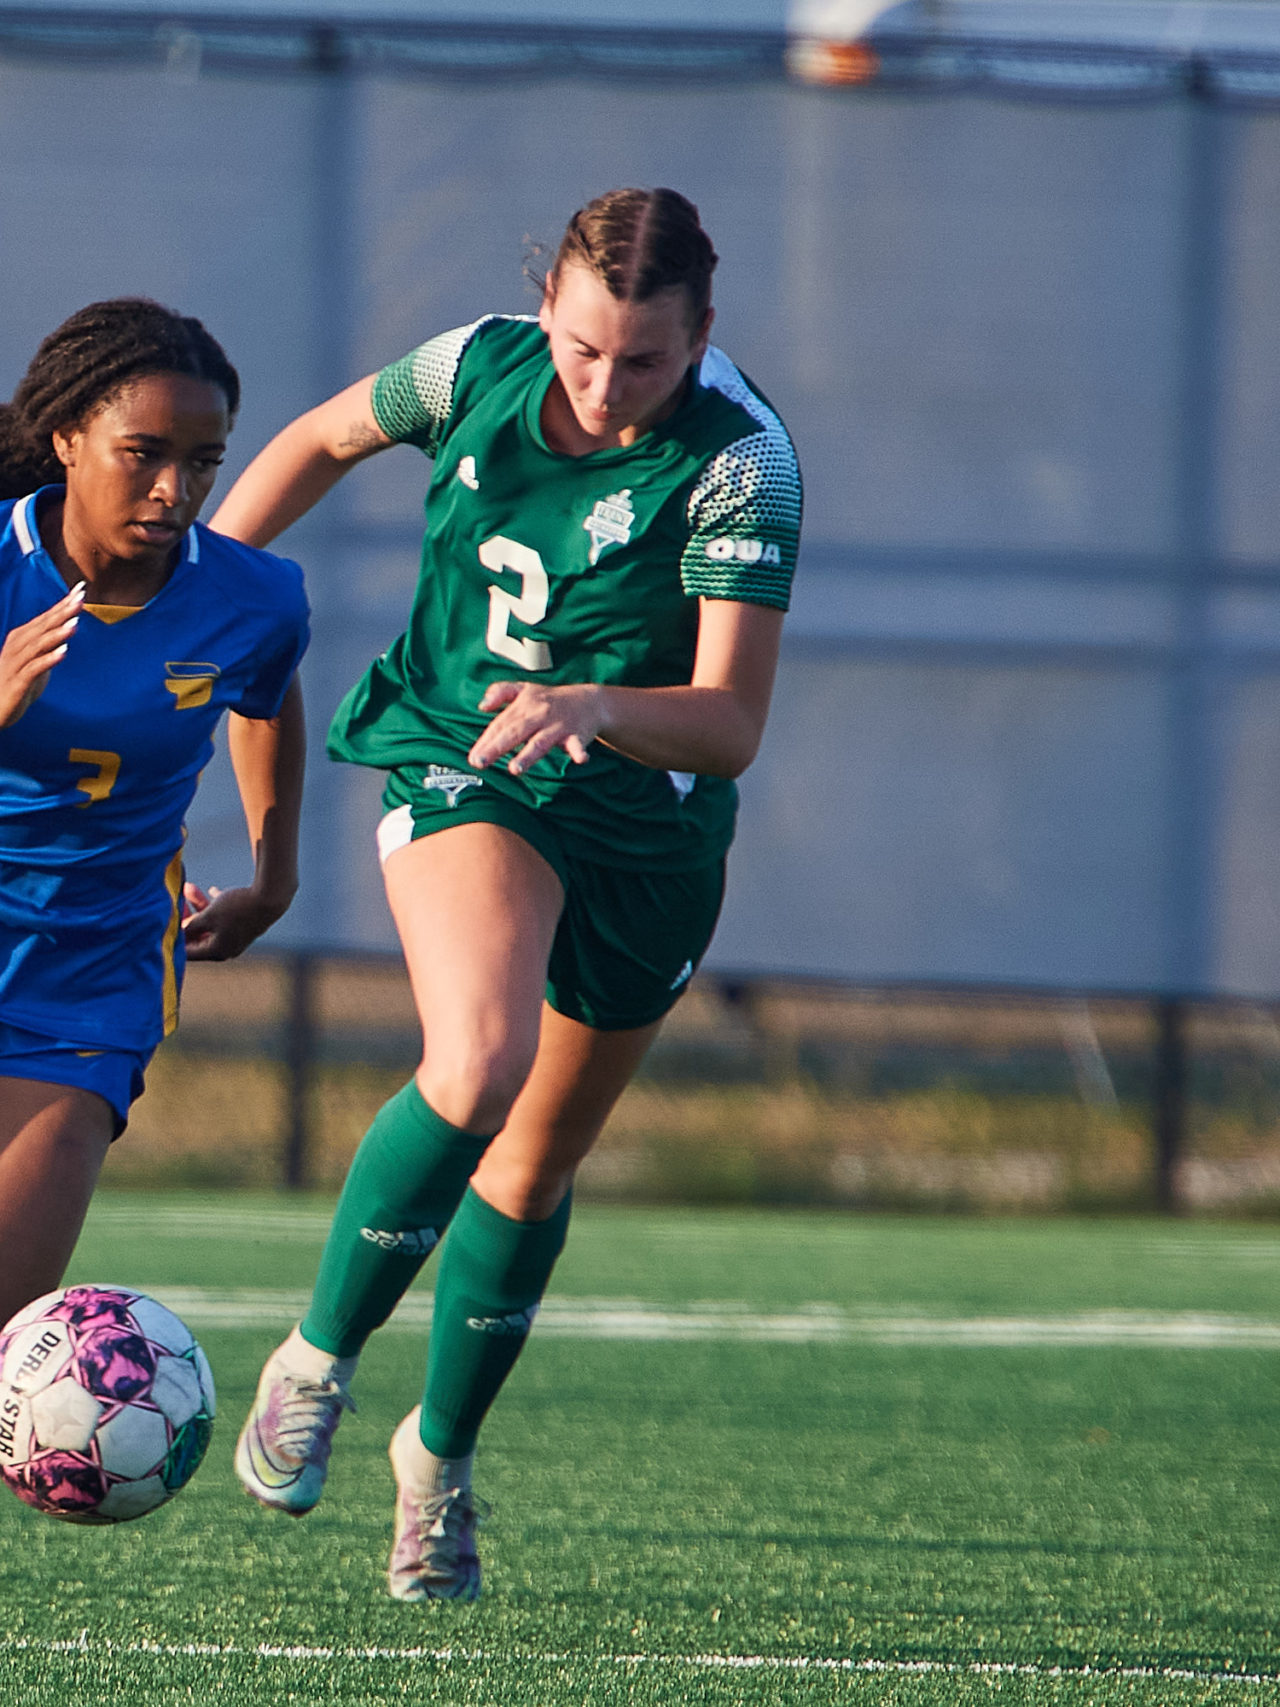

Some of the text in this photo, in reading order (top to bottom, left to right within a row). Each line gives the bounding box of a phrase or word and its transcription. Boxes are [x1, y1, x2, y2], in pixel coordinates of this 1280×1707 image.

[704, 536, 780, 564] OUA
[478, 534, 553, 671] 2
[360, 1227, 432, 1255] adid
